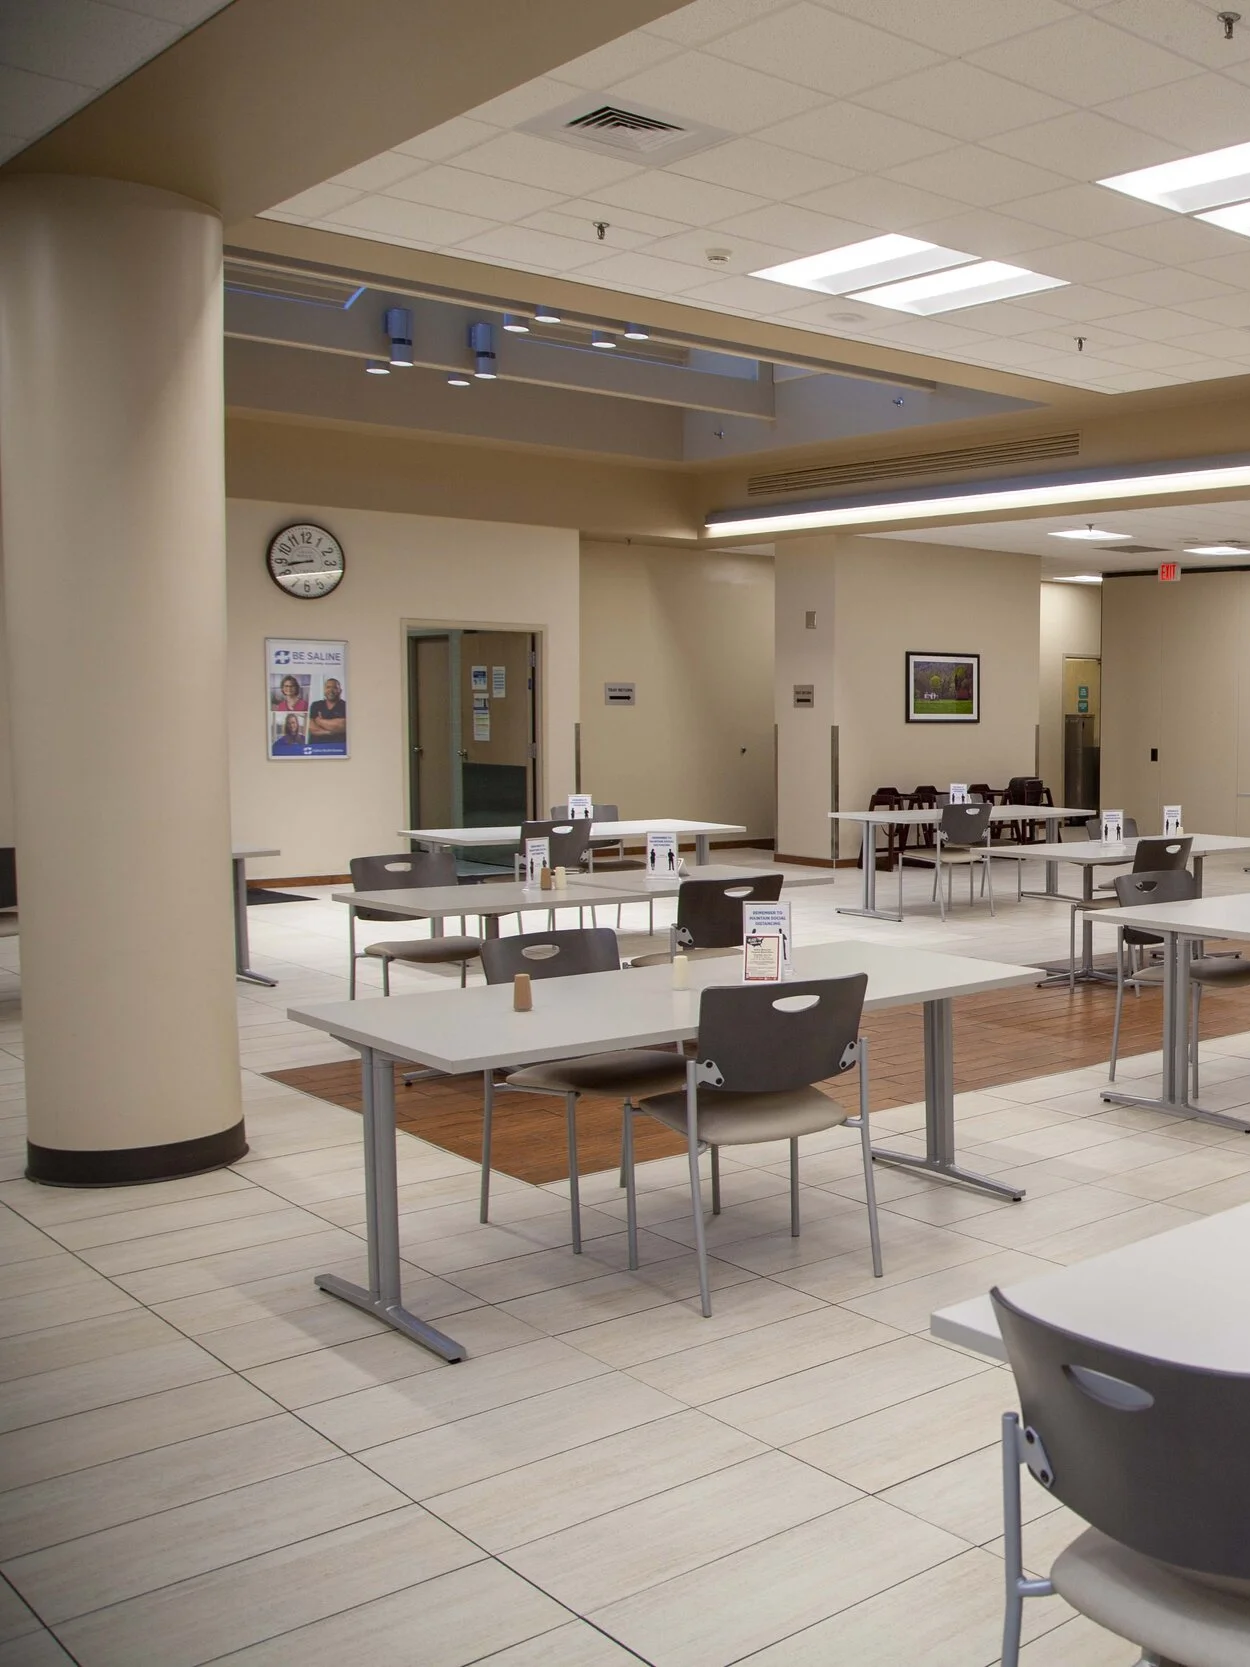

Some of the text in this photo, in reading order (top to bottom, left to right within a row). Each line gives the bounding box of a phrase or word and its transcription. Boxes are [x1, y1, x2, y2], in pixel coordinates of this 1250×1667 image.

[288, 534, 300, 547] 11
[301, 531, 312, 544] 12
[315, 537, 323, 548] 1
[278, 543, 292, 556] 10
[321, 547, 334, 556] 2
[274, 558, 288, 567] 9
[1161, 564, 1177, 580] EXIT
[303, 580, 311, 592] 6
[292, 651, 341, 661] BE SALINE
